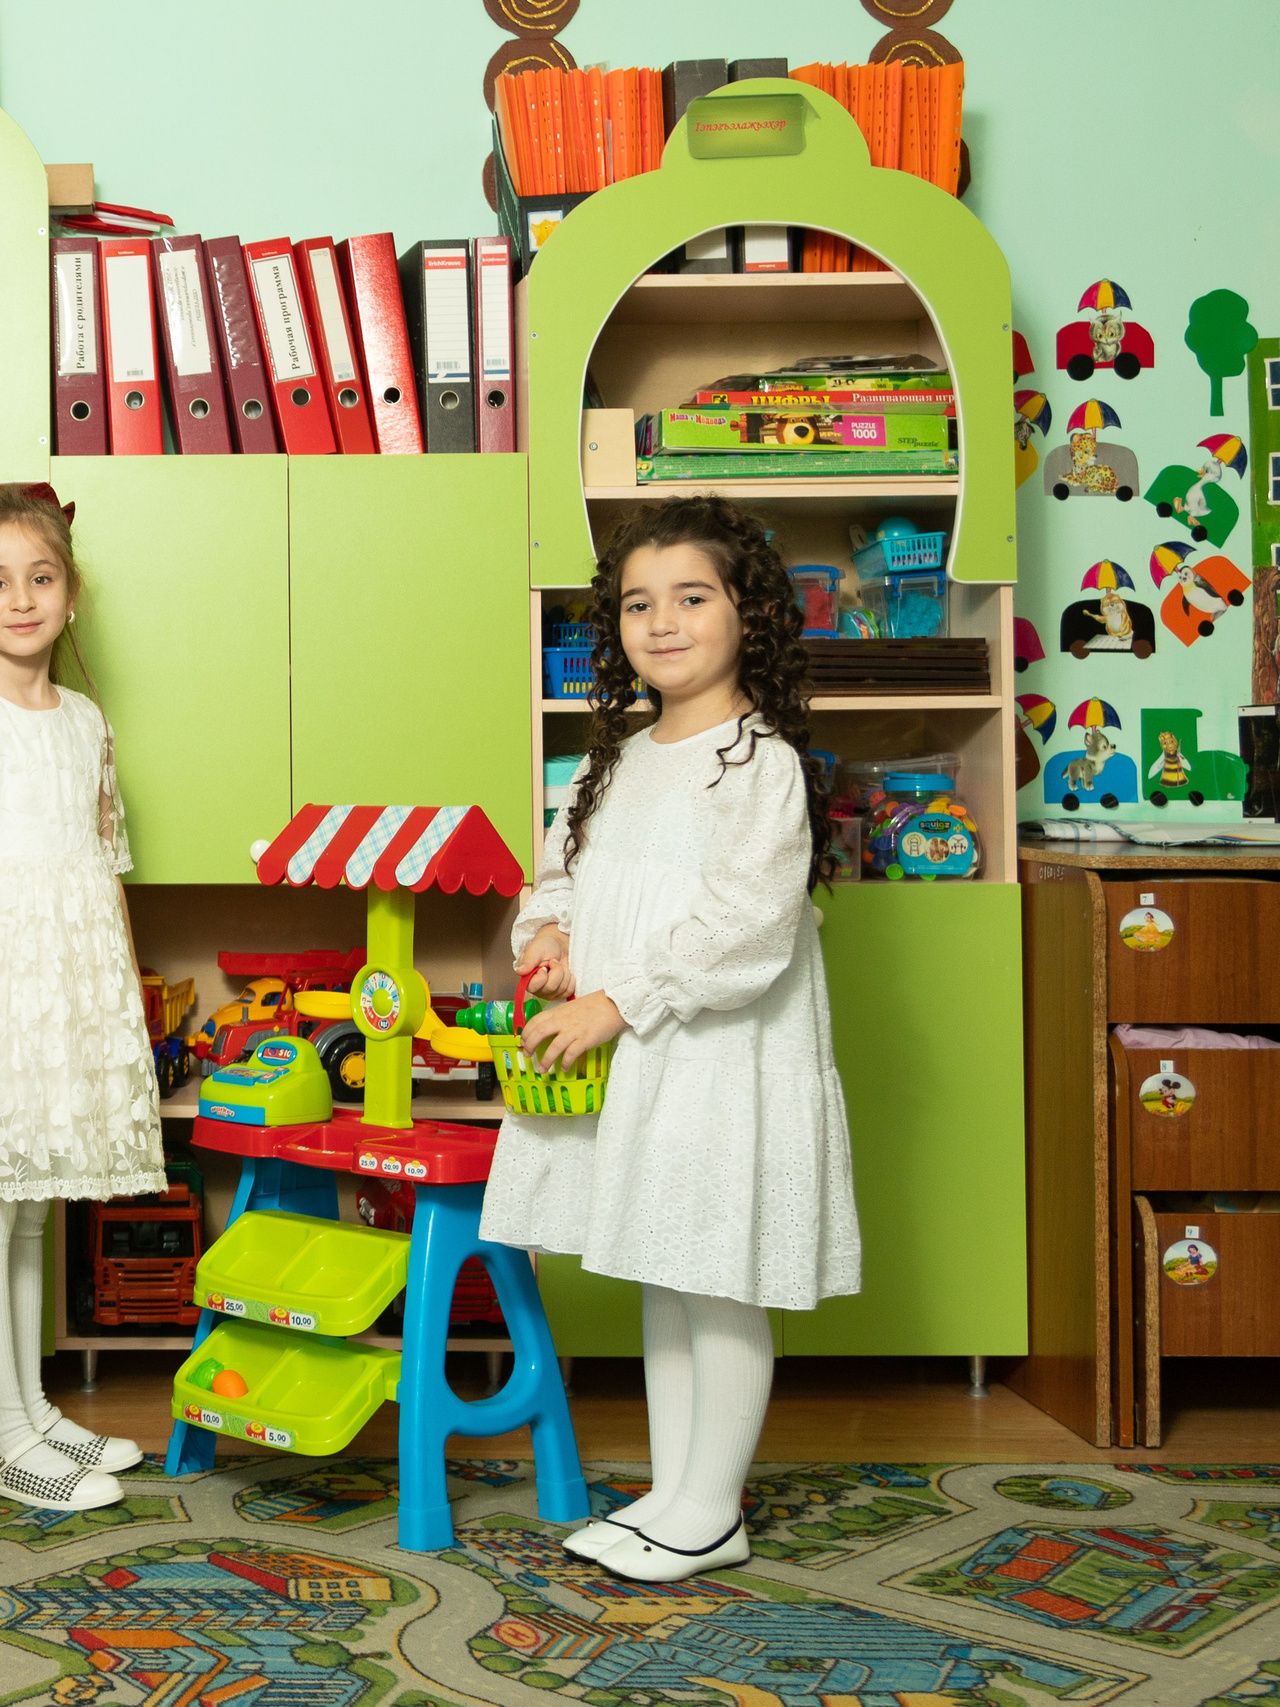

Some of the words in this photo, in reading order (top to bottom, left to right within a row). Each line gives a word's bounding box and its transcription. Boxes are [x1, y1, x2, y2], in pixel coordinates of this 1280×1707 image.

[75, 257, 86, 321] родителями
[272, 265, 291, 324] программа
[76, 333, 85, 369] Работа
[284, 326, 301, 370] Рабочая
[751, 395, 831, 405] ЦИФРЫ
[852, 393, 933, 403] Развивающая
[669, 412, 689, 423] Маша
[695, 414, 727, 426] Медведь
[852, 429, 877, 439] 1000
[920, 819, 951, 831] squigz
[1142, 895, 1147, 903] 7
[1161, 1062, 1167, 1071] 8
[383, 1163, 399, 1171] 20.00
[1187, 1228, 1193, 1236] 9
[225, 1301, 244, 1311] 25.00
[291, 1315, 312, 1326] 10.00
[202, 1413, 220, 1424] 10.00
[268, 1432, 286, 1442] 5.00
